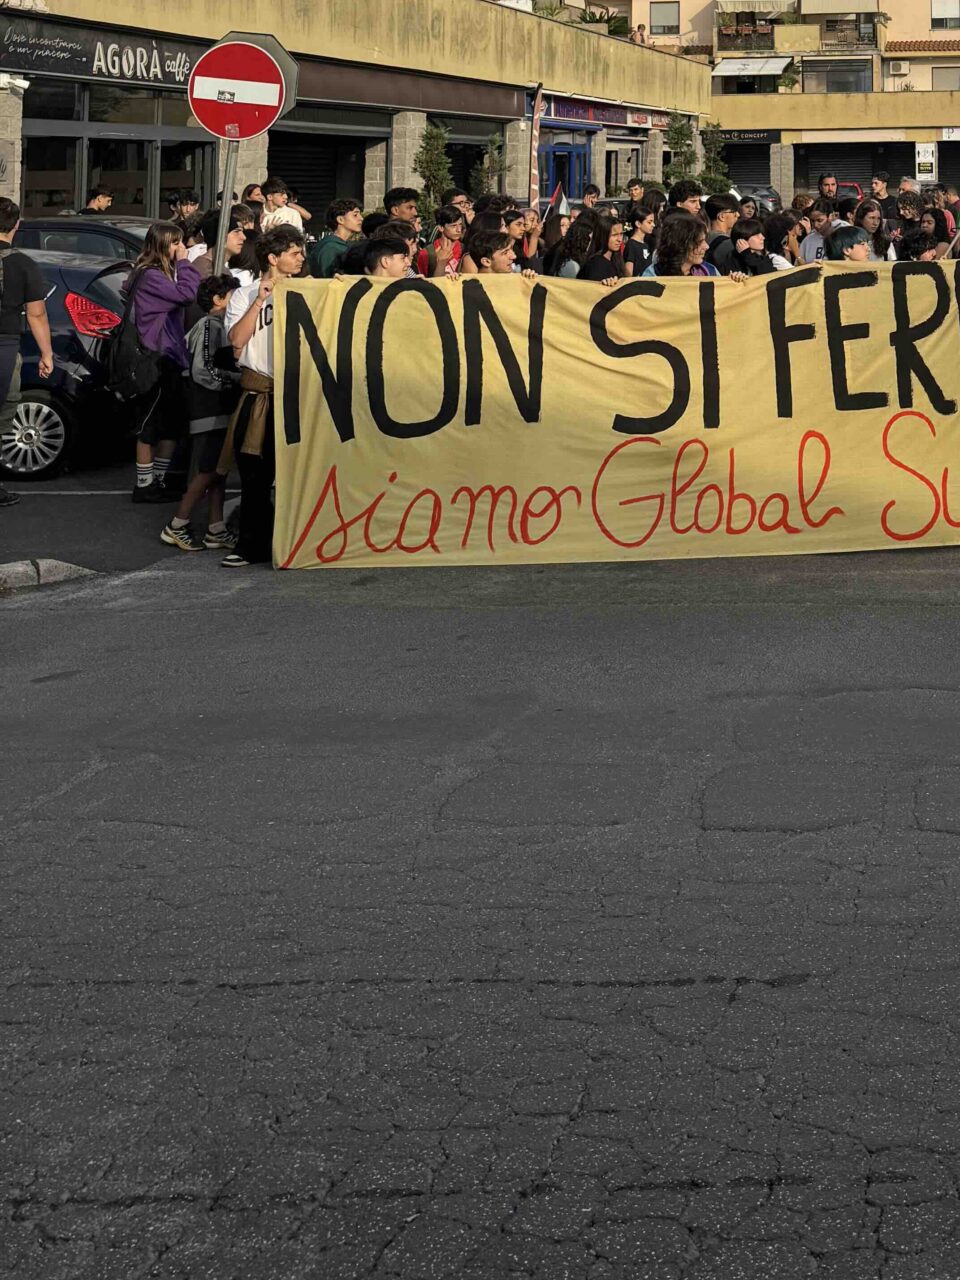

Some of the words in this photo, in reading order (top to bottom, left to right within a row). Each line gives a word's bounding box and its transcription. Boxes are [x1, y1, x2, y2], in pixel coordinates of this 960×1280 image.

[92, 40, 163, 81] AGORÀ
[165, 52, 190, 82] caffè
[282, 278, 548, 445] NON
[589, 280, 720, 435] SI
[592, 430, 846, 549] Global
